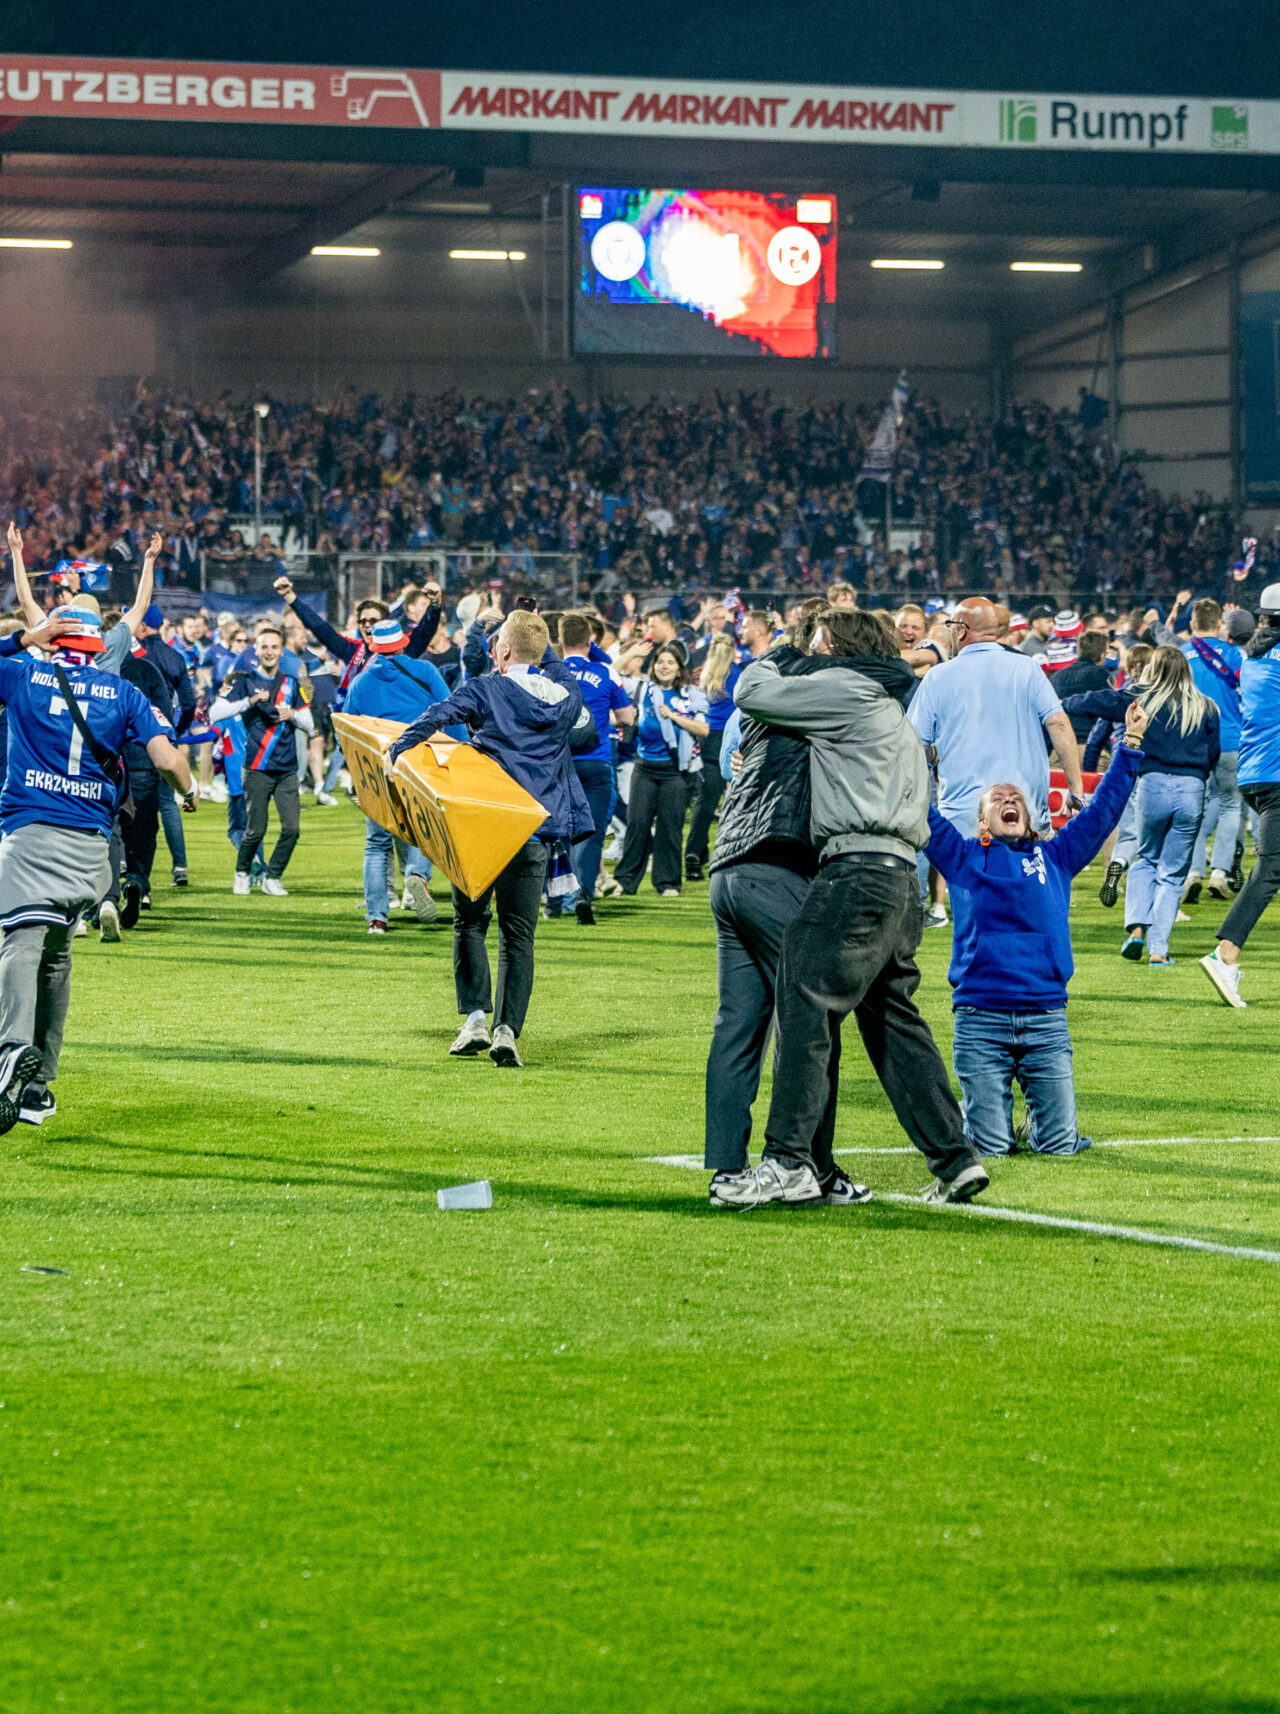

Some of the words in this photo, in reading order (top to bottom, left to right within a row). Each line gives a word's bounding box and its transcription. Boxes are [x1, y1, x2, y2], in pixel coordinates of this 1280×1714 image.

[449, 85, 620, 121] MARKANT
[622, 92, 788, 126] MARKANT
[790, 99, 955, 133] MARKANT
[1050, 100, 1188, 149] Rumpf
[90, 684, 118, 700] KIEL
[48, 695, 90, 776] 7
[24, 769, 103, 801] SKRZYBSKI
